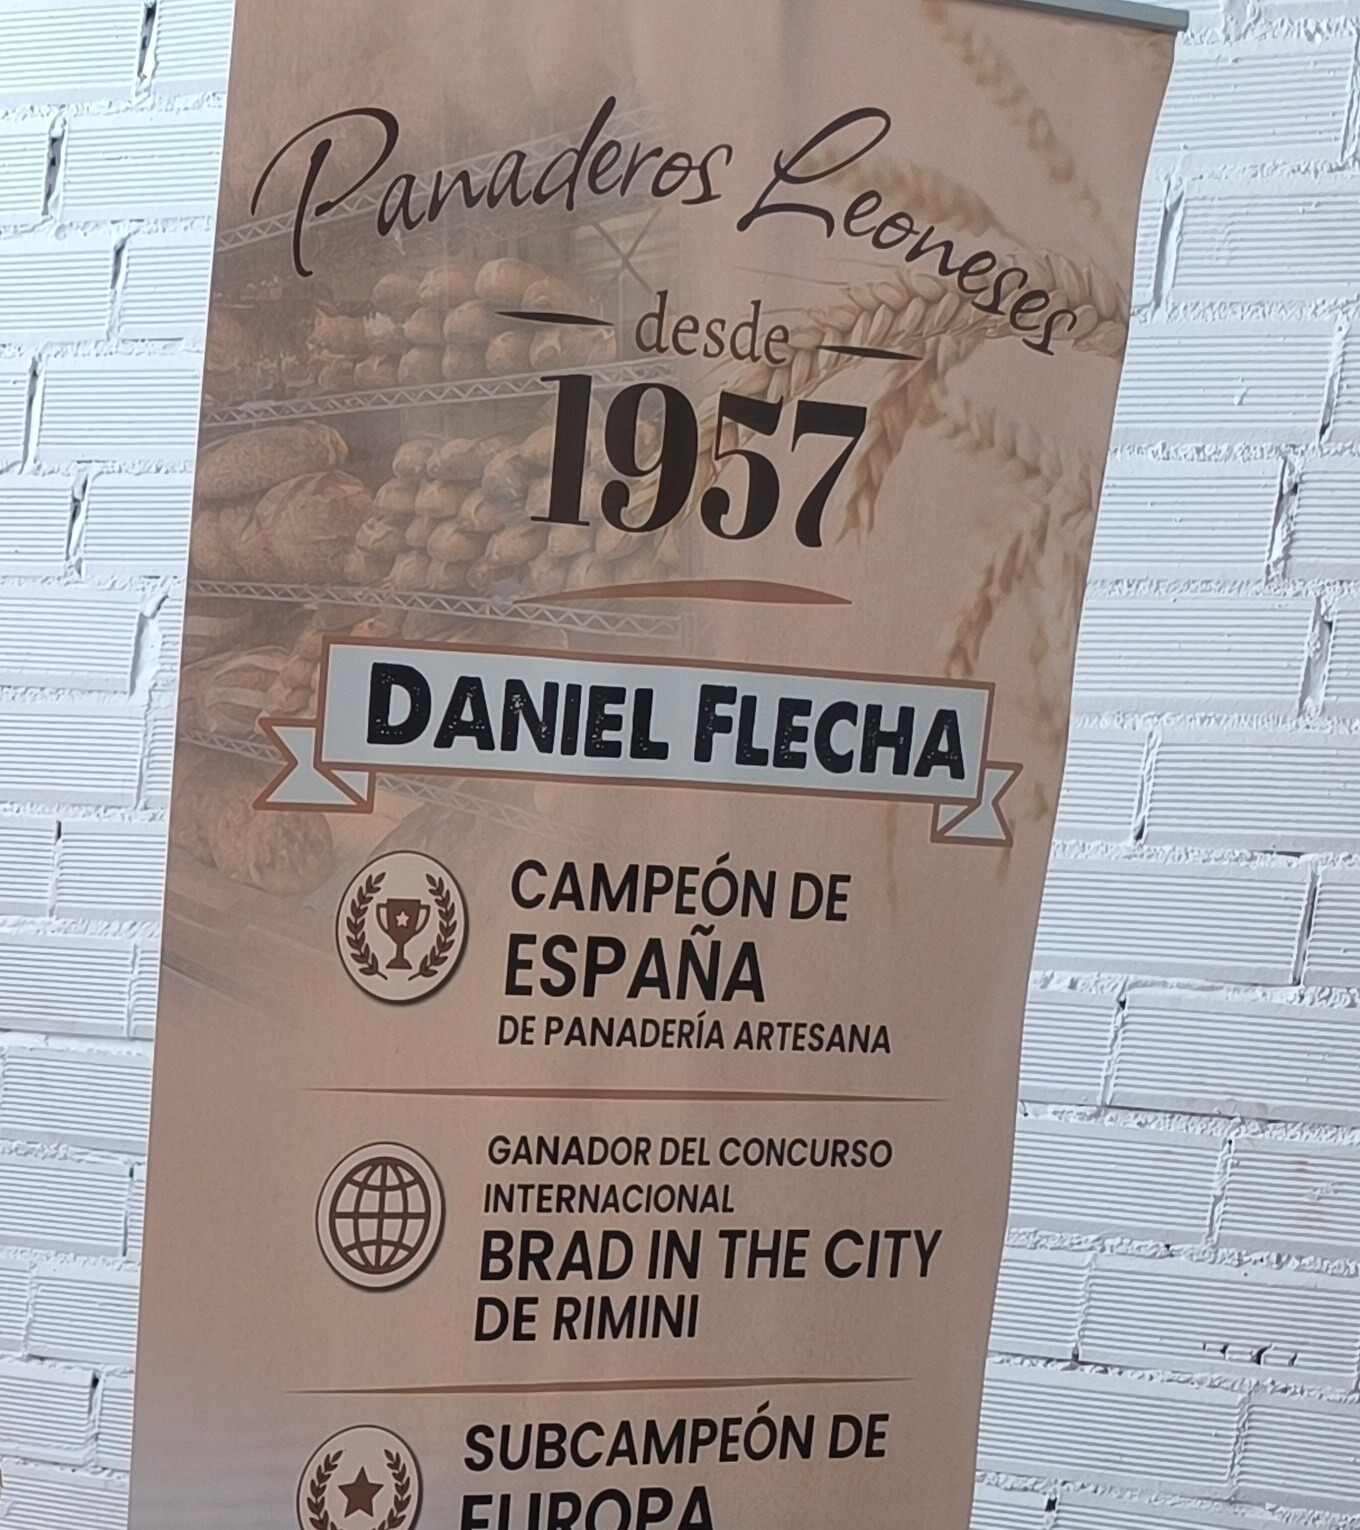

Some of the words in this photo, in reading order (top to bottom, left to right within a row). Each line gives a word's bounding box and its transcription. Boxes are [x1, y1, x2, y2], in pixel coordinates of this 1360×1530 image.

[250, 95, 733, 277] Panaderos
[737, 107, 1077, 356] Leoneses
[635, 289, 791, 366] desde
[530, 374, 868, 548] 1957
[366, 662, 668, 761] DANIEL
[694, 686, 965, 780] FLECHA
[510, 853, 776, 918] CAMPEÓN
[789, 874, 851, 921] DE
[505, 925, 765, 1003] ESPAÑA
[499, 1016, 537, 1046] DE
[544, 1010, 725, 1050] PANADERÍA
[734, 1021, 892, 1054] ARTESANA
[487, 1135, 651, 1166] GANADOR
[660, 1138, 710, 1166] DEL
[718, 1138, 893, 1169] CONCURSO
[484, 1184, 734, 1213] INTERNACIONAL
[480, 1230, 634, 1281] BRAD
[648, 1230, 700, 1279] IN
[719, 1229, 810, 1279] THE
[824, 1229, 942, 1278] CITY
[475, 1296, 537, 1341] DE
[553, 1295, 698, 1339] RIMINI
[464, 1402, 814, 1471] SUBCAMPEÓN
[828, 1413, 889, 1459] DE
